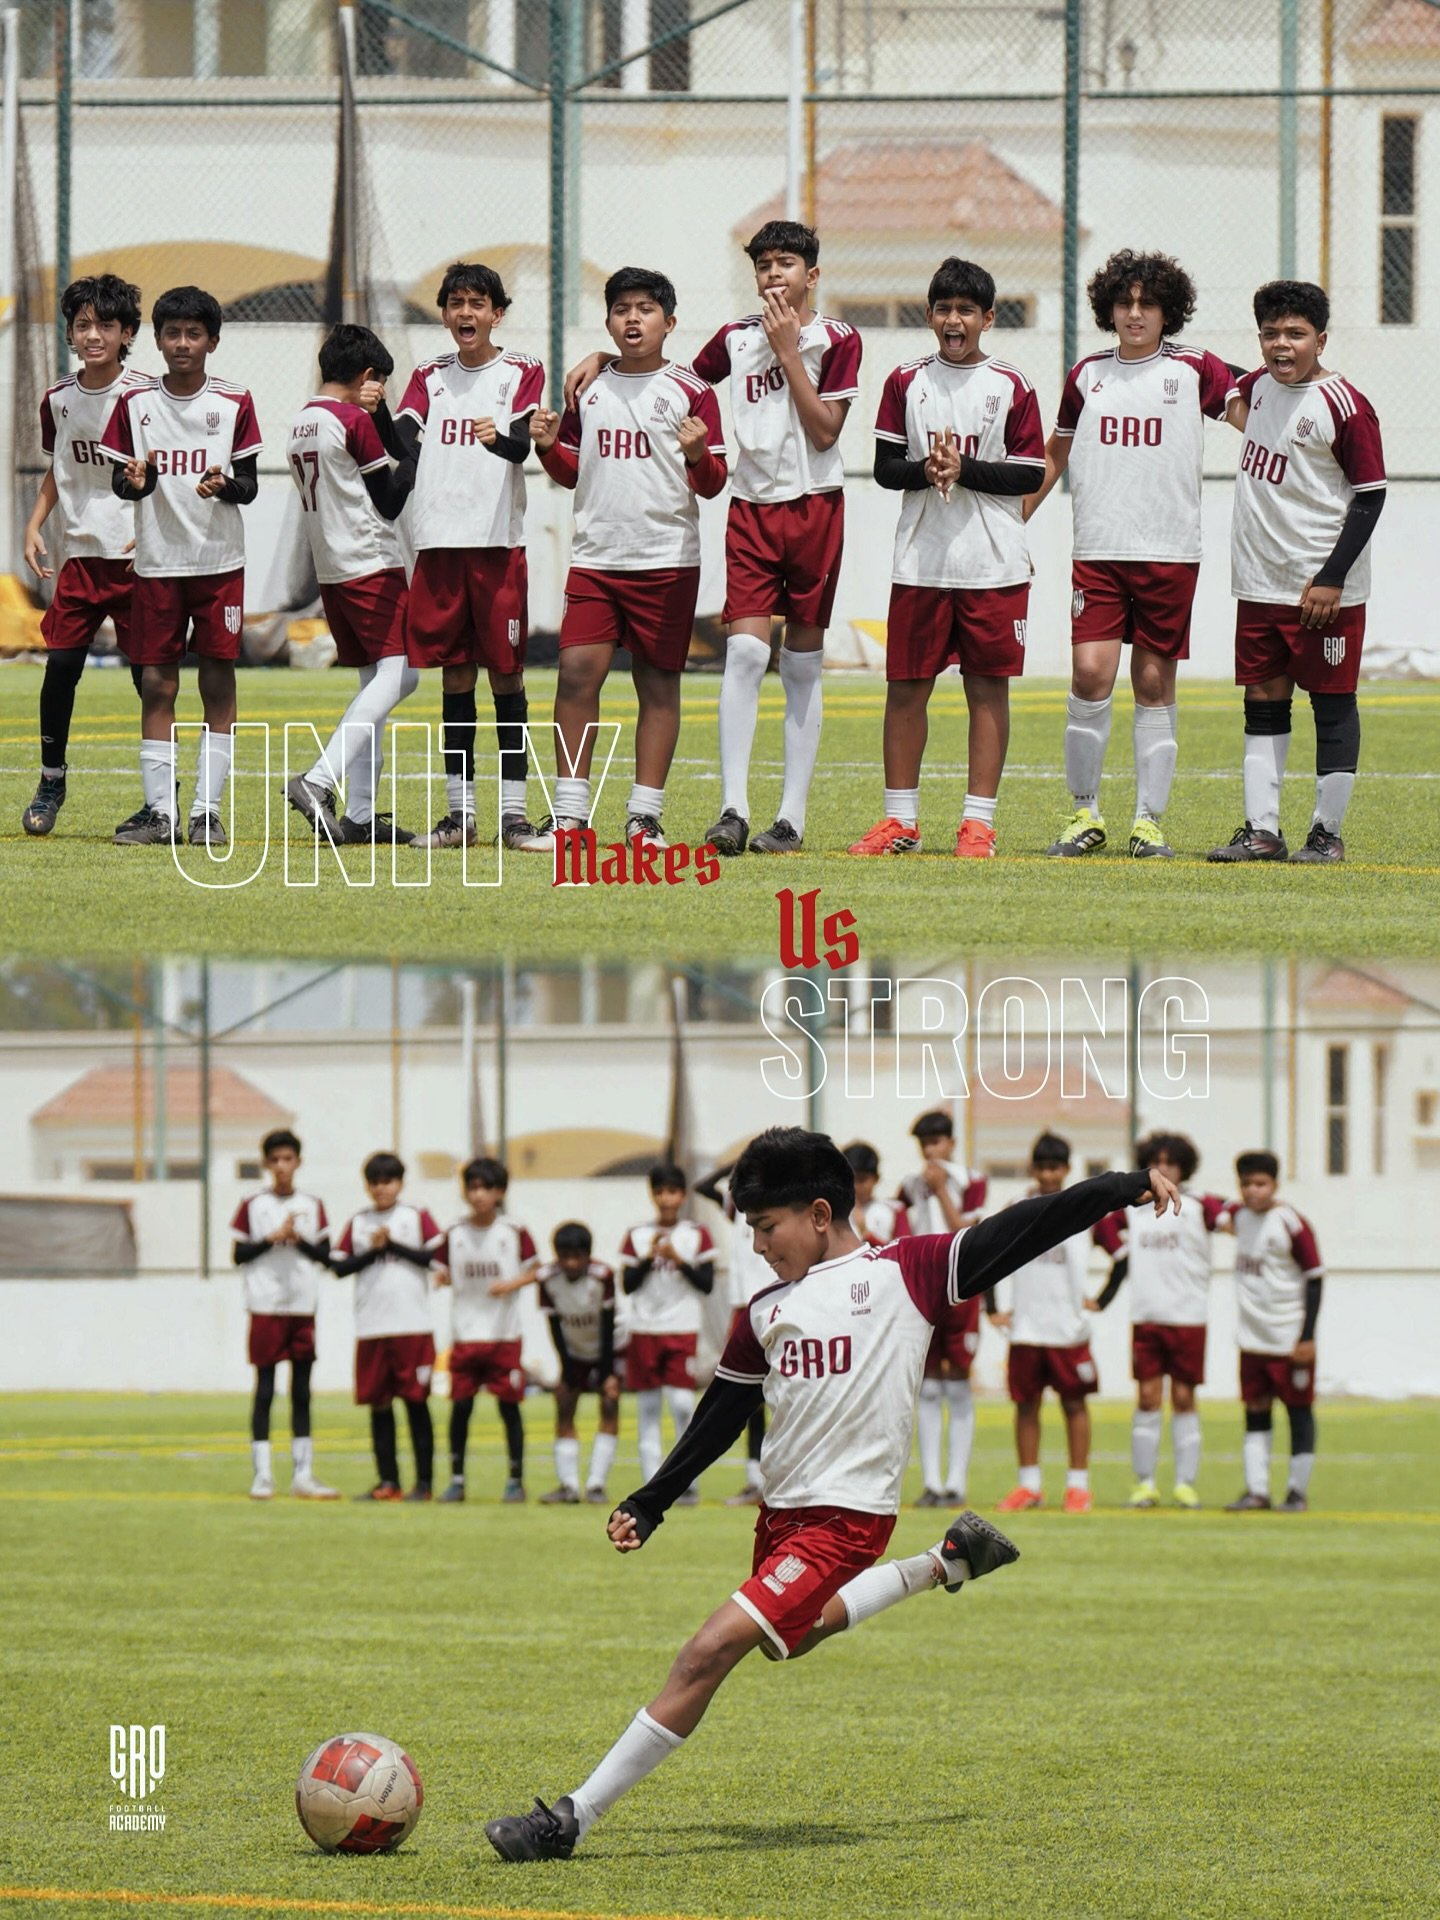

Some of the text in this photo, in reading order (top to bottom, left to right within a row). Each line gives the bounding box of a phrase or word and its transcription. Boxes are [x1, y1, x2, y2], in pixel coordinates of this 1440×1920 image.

[292, 422, 319, 440] KASHI
[441, 418, 476, 446] GR
[597, 428, 652, 459] GRO
[1100, 415, 1163, 447] GRO
[72, 439, 114, 466] GR
[153, 448, 207, 476] GRO
[1241, 439, 1289, 485] GRO
[291, 451, 320, 512] 17
[1323, 636, 1346, 666] GRO
[780, 1335, 852, 1379] GRO
[378, 1769, 398, 1804] molten
